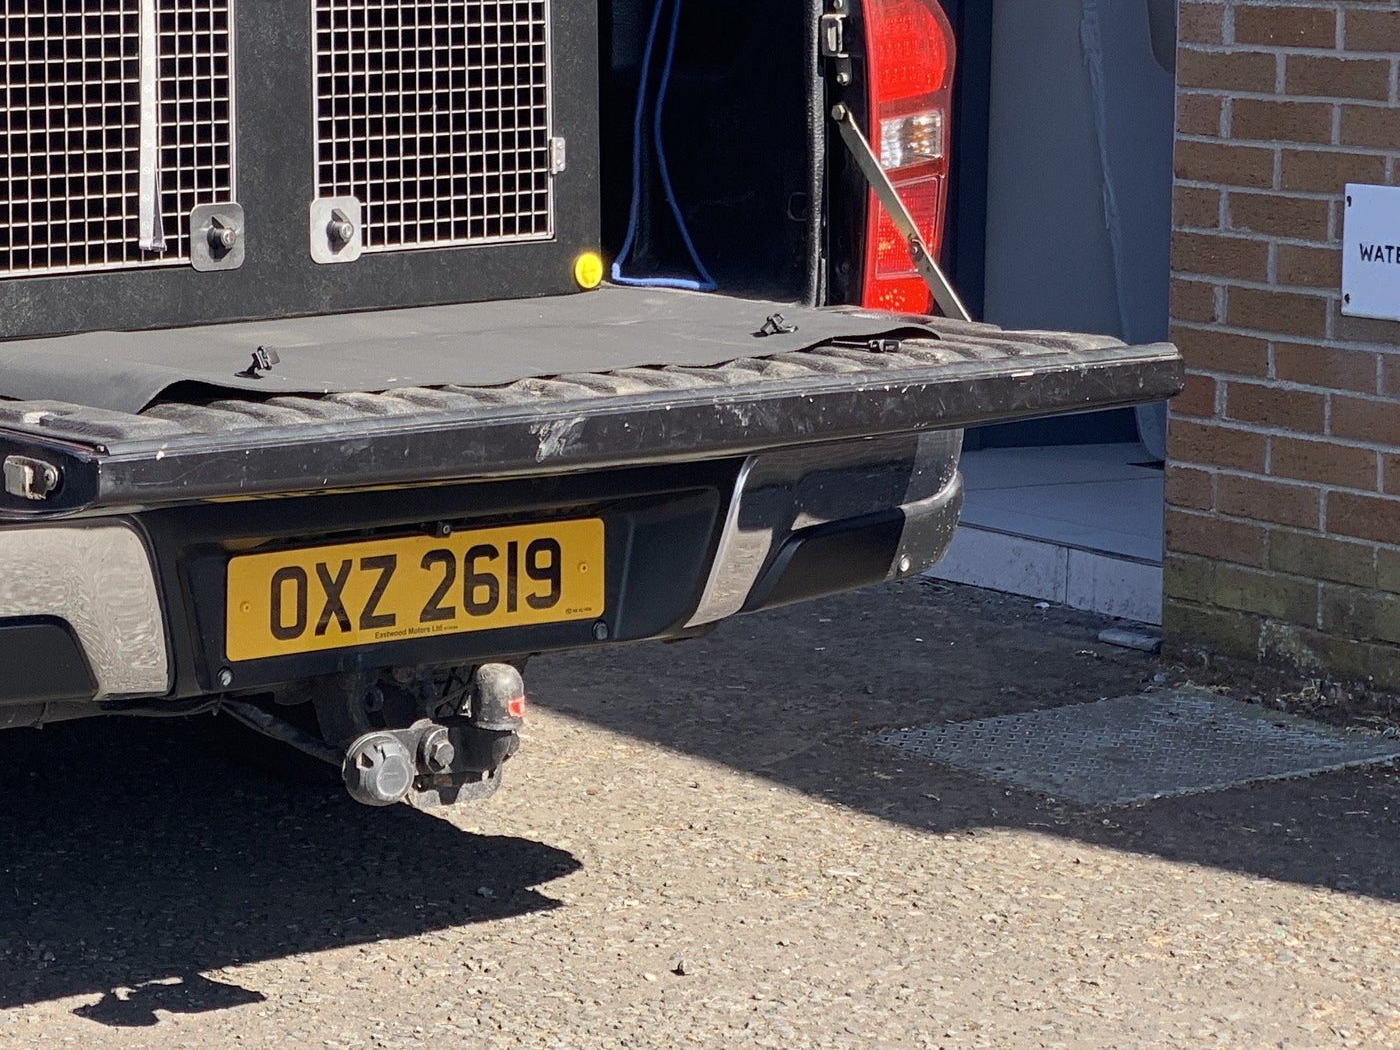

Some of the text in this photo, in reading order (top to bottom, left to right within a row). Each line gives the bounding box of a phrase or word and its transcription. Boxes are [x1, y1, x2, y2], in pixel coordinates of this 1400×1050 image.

[270, 537, 562, 641] OXZ 2619
[374, 629, 407, 640] Eastwood
[407, 626, 431, 636] Motors
[431, 624, 444, 632] Ltd
